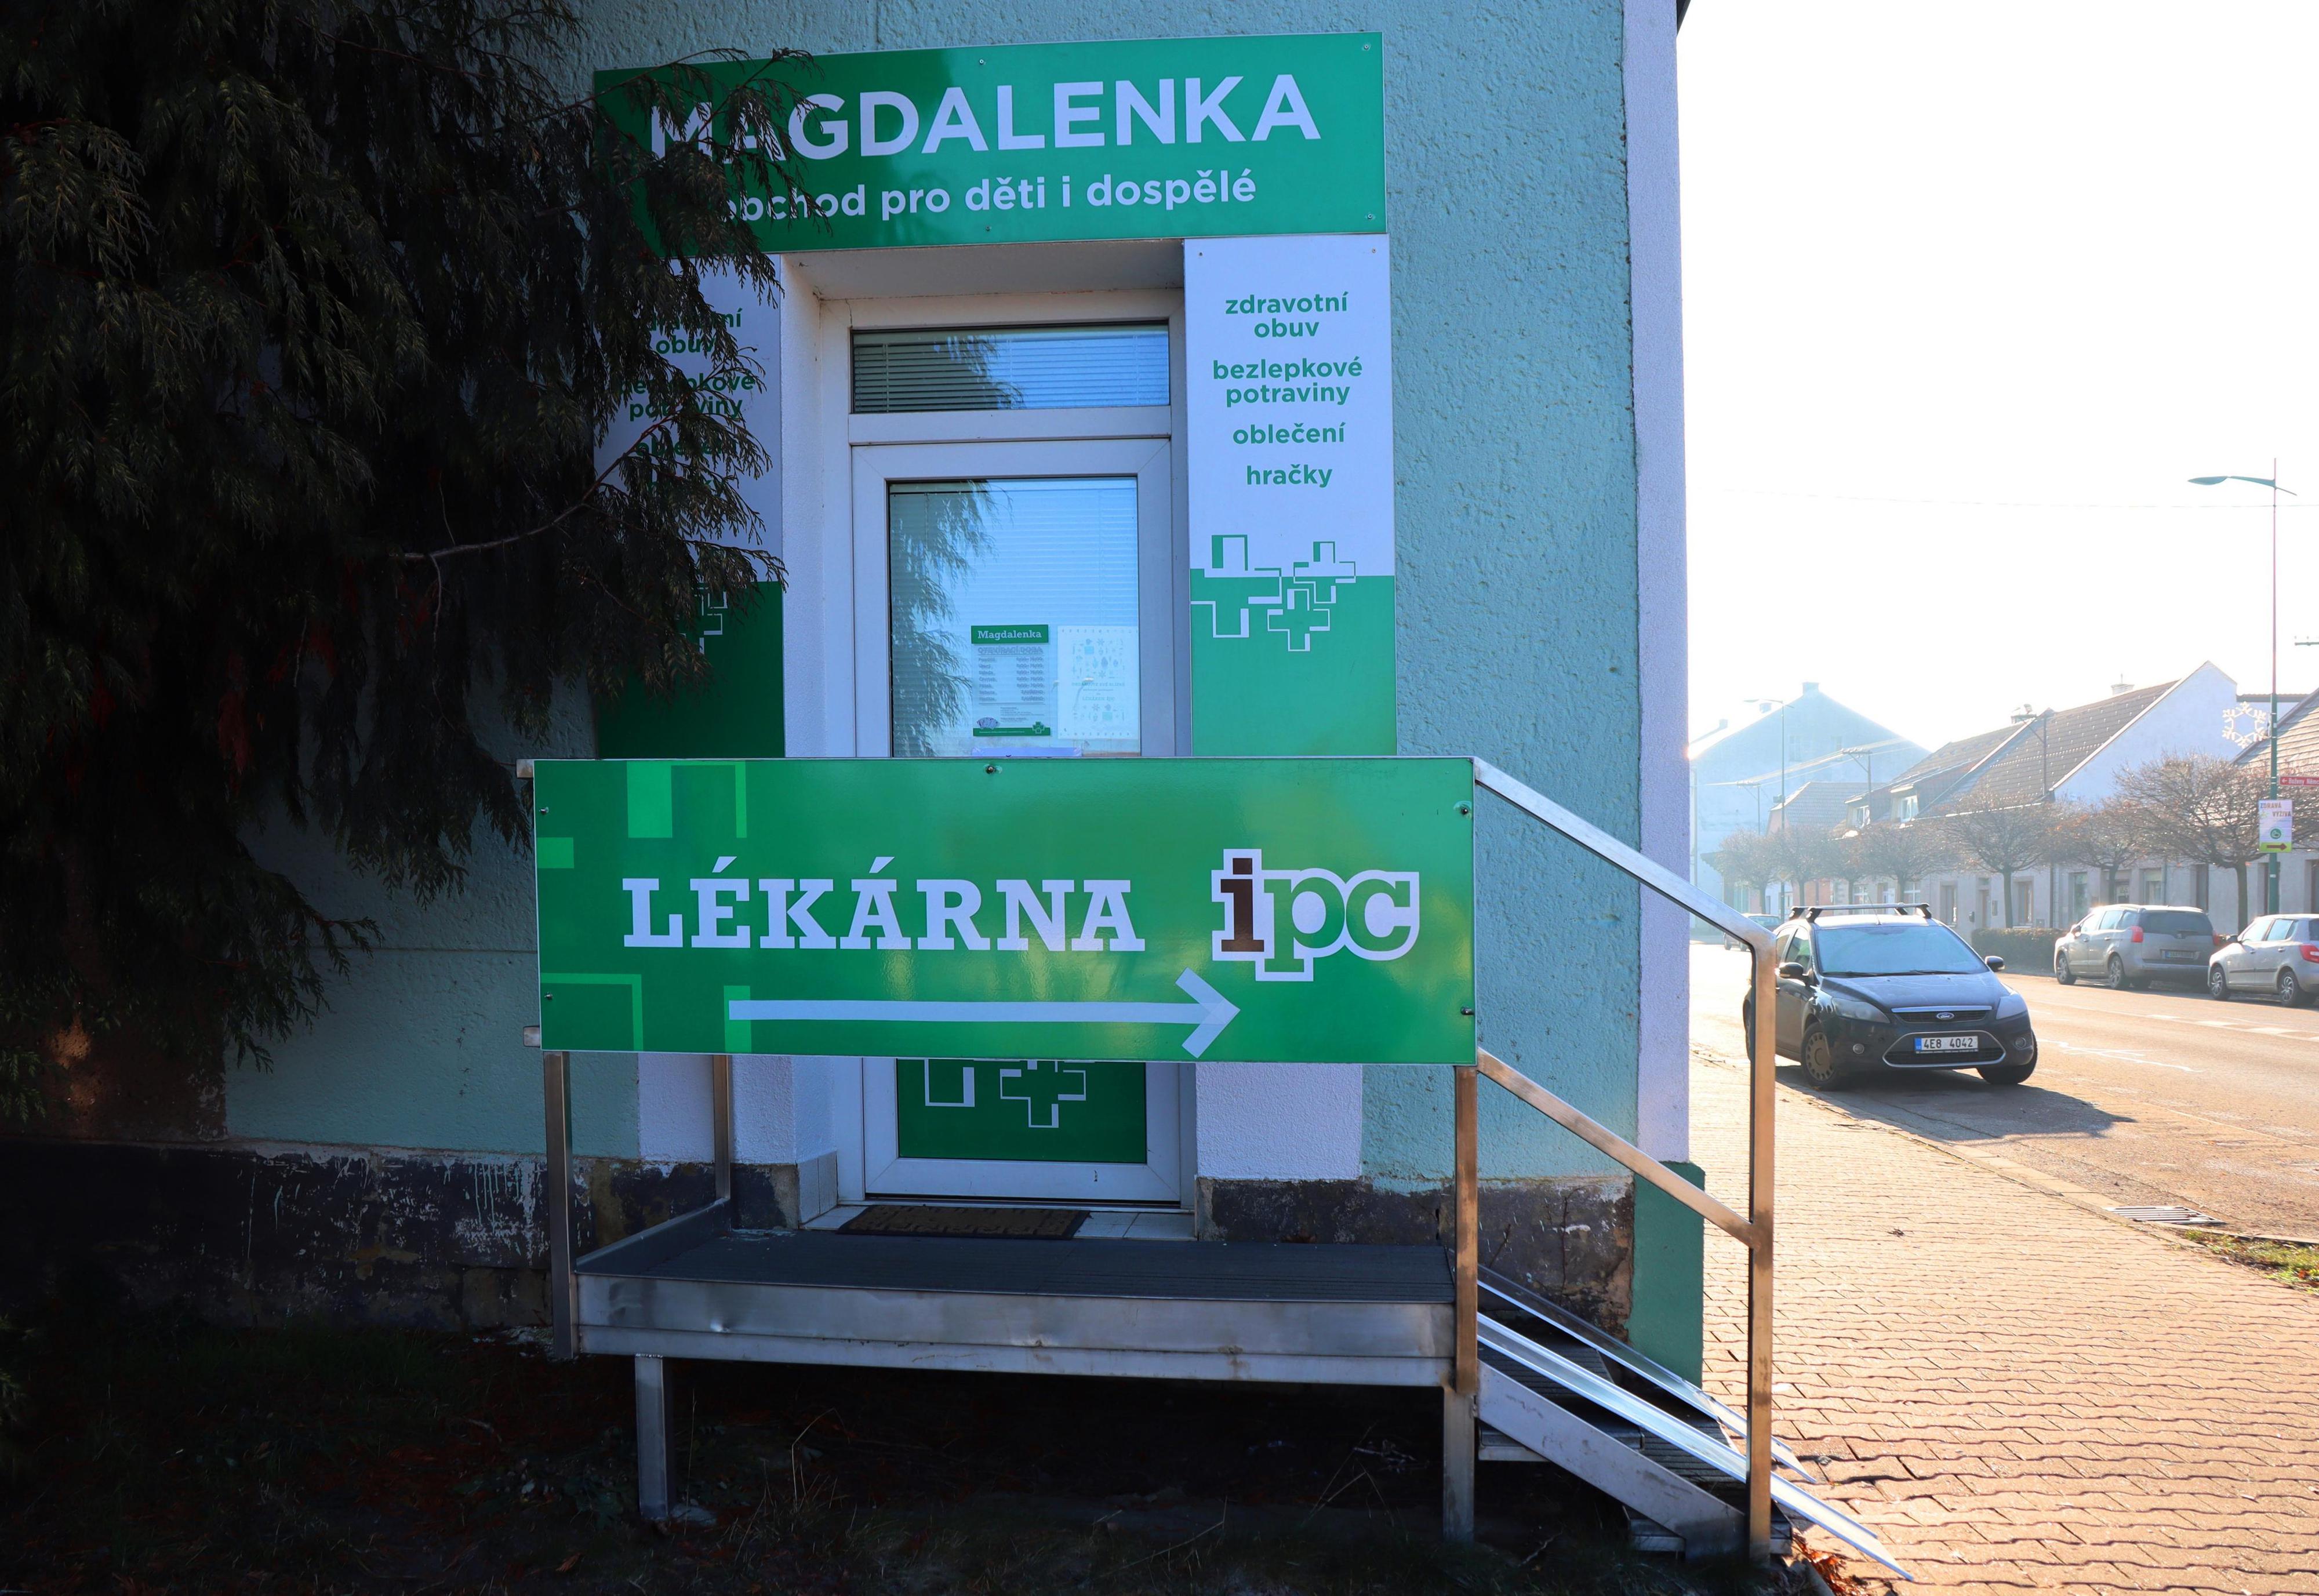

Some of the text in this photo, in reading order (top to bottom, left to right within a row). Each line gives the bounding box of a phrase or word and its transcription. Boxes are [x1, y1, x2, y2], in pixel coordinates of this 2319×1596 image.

[650, 74, 1321, 165] MAGDALENKA
[882, 185, 950, 220] pro
[965, 176, 1044, 211] děti
[1062, 176, 1071, 207] i
[1086, 168, 1256, 210] dospělé
[1225, 291, 1348, 314] zdravotní
[1254, 318, 1320, 338] obuv
[1213, 356, 1362, 381] bezlepkové
[1226, 382, 1350, 408] potraviny
[1233, 422, 1346, 443] oblečení
[1246, 464, 1333, 488] hračky
[977, 630, 1042, 641] Magdalenka
[622, 853, 1416, 977] LÉKÁRNA ipc
[1924, 1038, 1973, 1049] 4E8 4042
